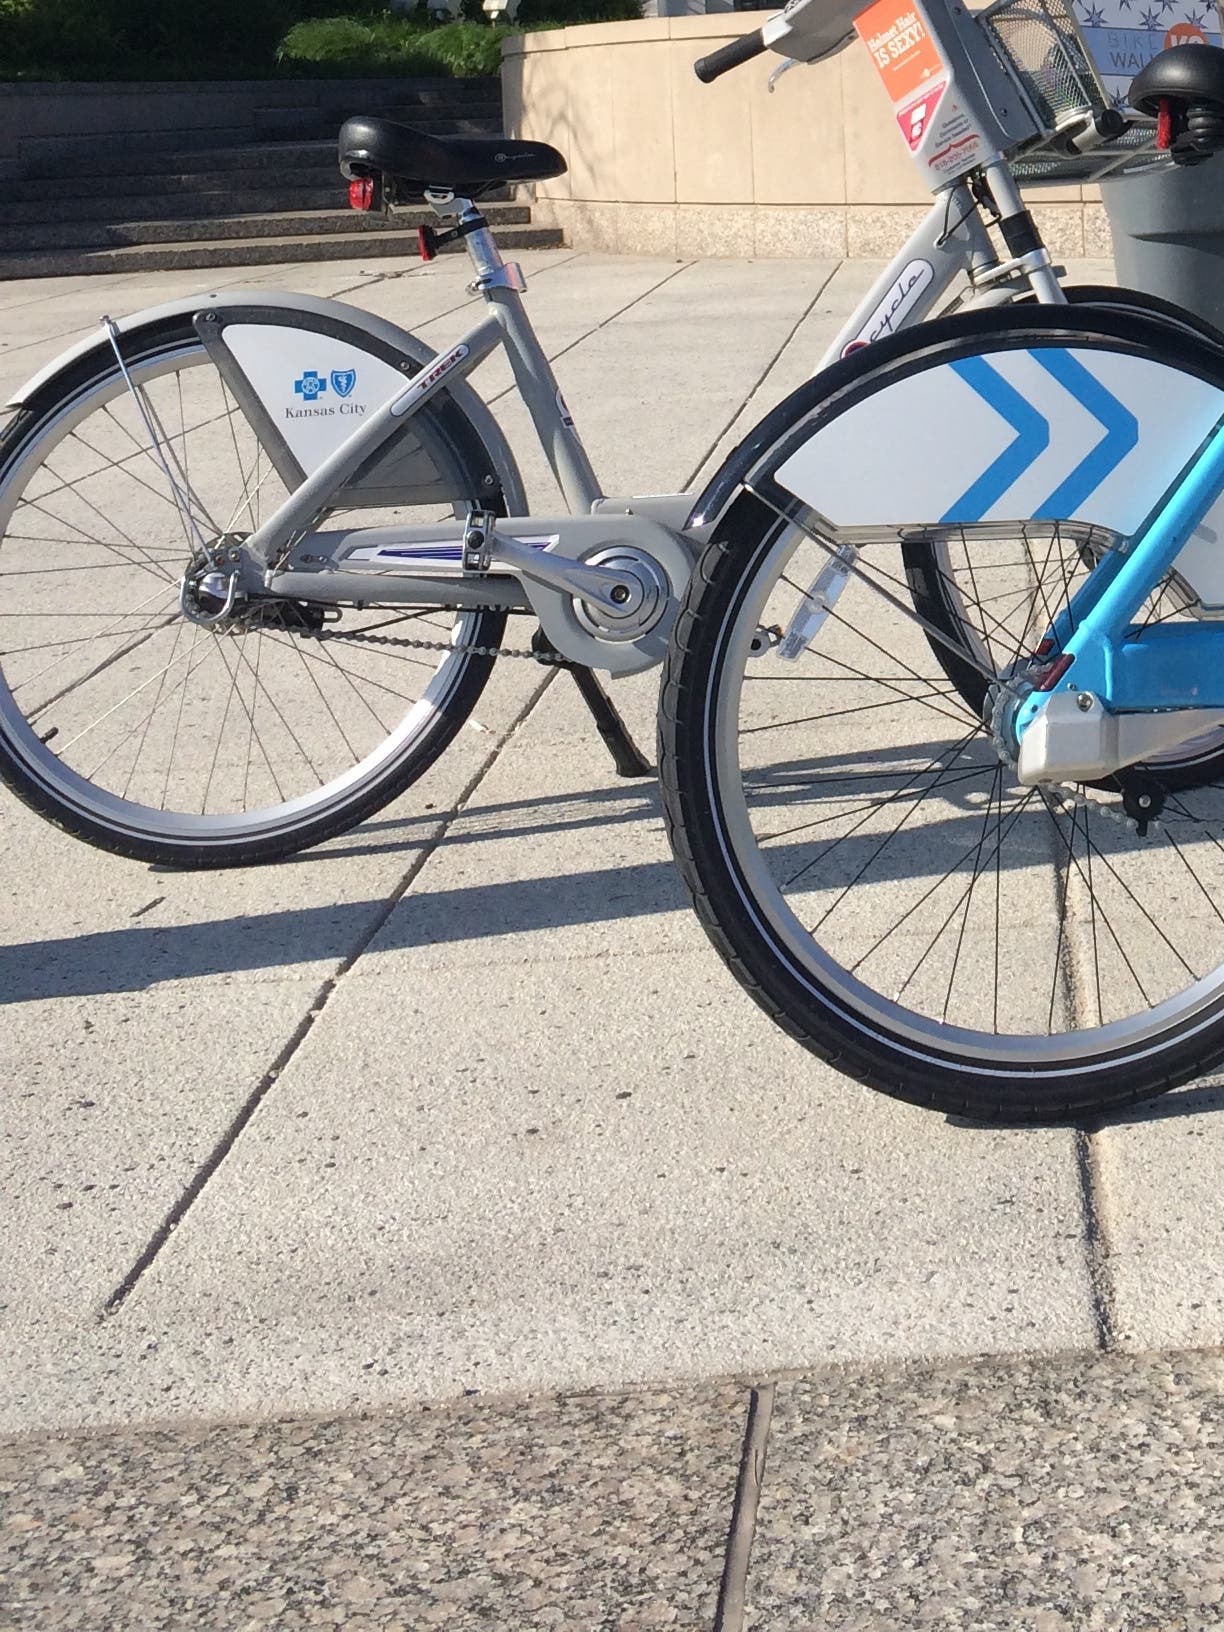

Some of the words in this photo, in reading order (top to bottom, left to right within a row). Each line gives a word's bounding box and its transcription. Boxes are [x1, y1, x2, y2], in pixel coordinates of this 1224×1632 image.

[897, 11, 917, 33] Hair
[874, 50, 891, 69] IS
[889, 23, 927, 60] SEXY!
[1109, 52, 1154, 68] WAL
[416, 351, 464, 390] TREK
[284, 405, 336, 419] Kansas
[339, 402, 368, 417] City
